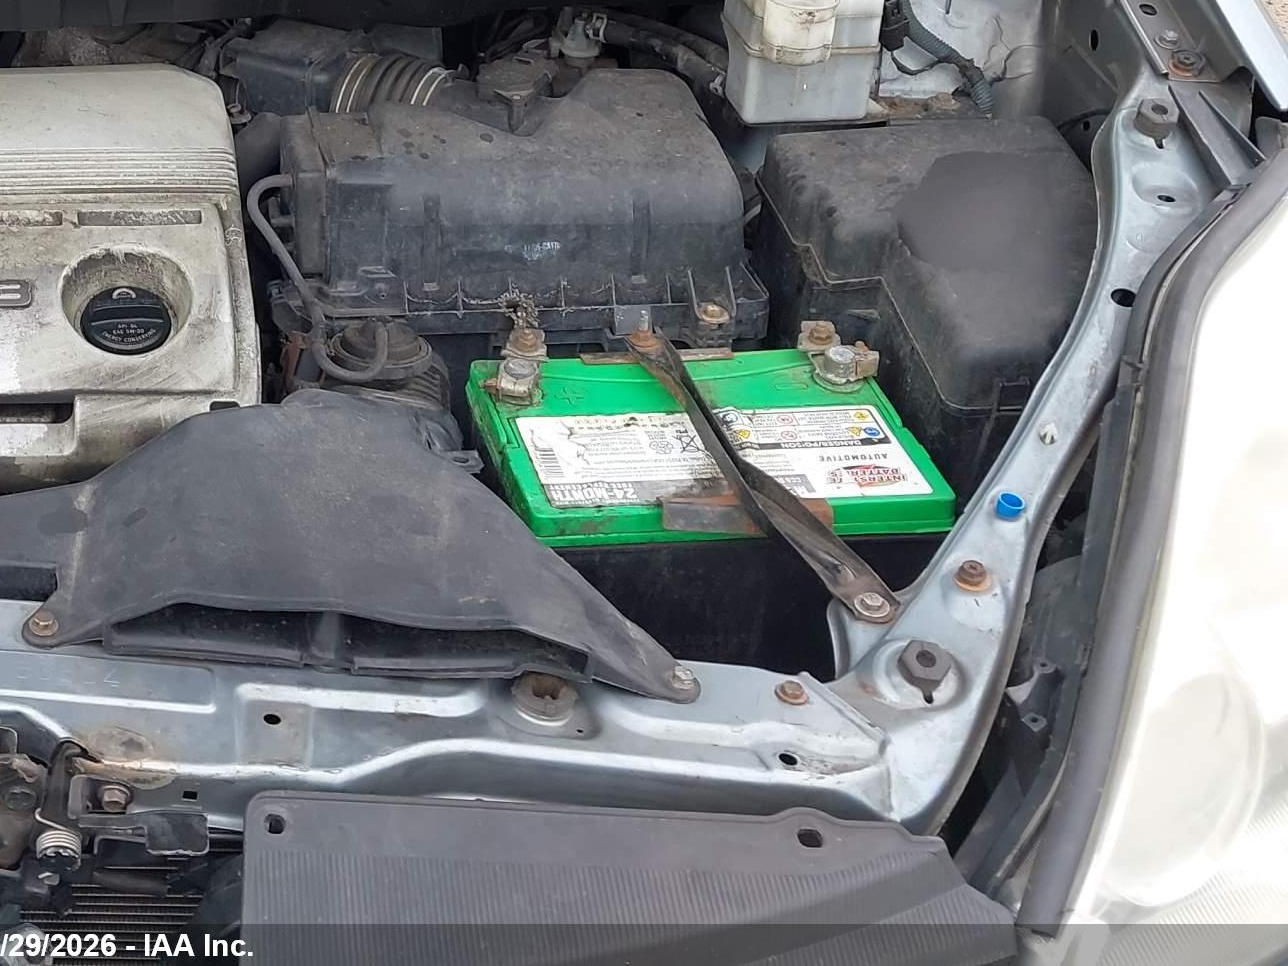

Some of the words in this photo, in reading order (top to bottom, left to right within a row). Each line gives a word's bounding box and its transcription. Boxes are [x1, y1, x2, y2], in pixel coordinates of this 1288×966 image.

[780, 440, 862, 448] DANGER/POISON
[818, 453, 887, 462] AUTOMOTIVE
[551, 487, 638, 501] 24-MONTH
